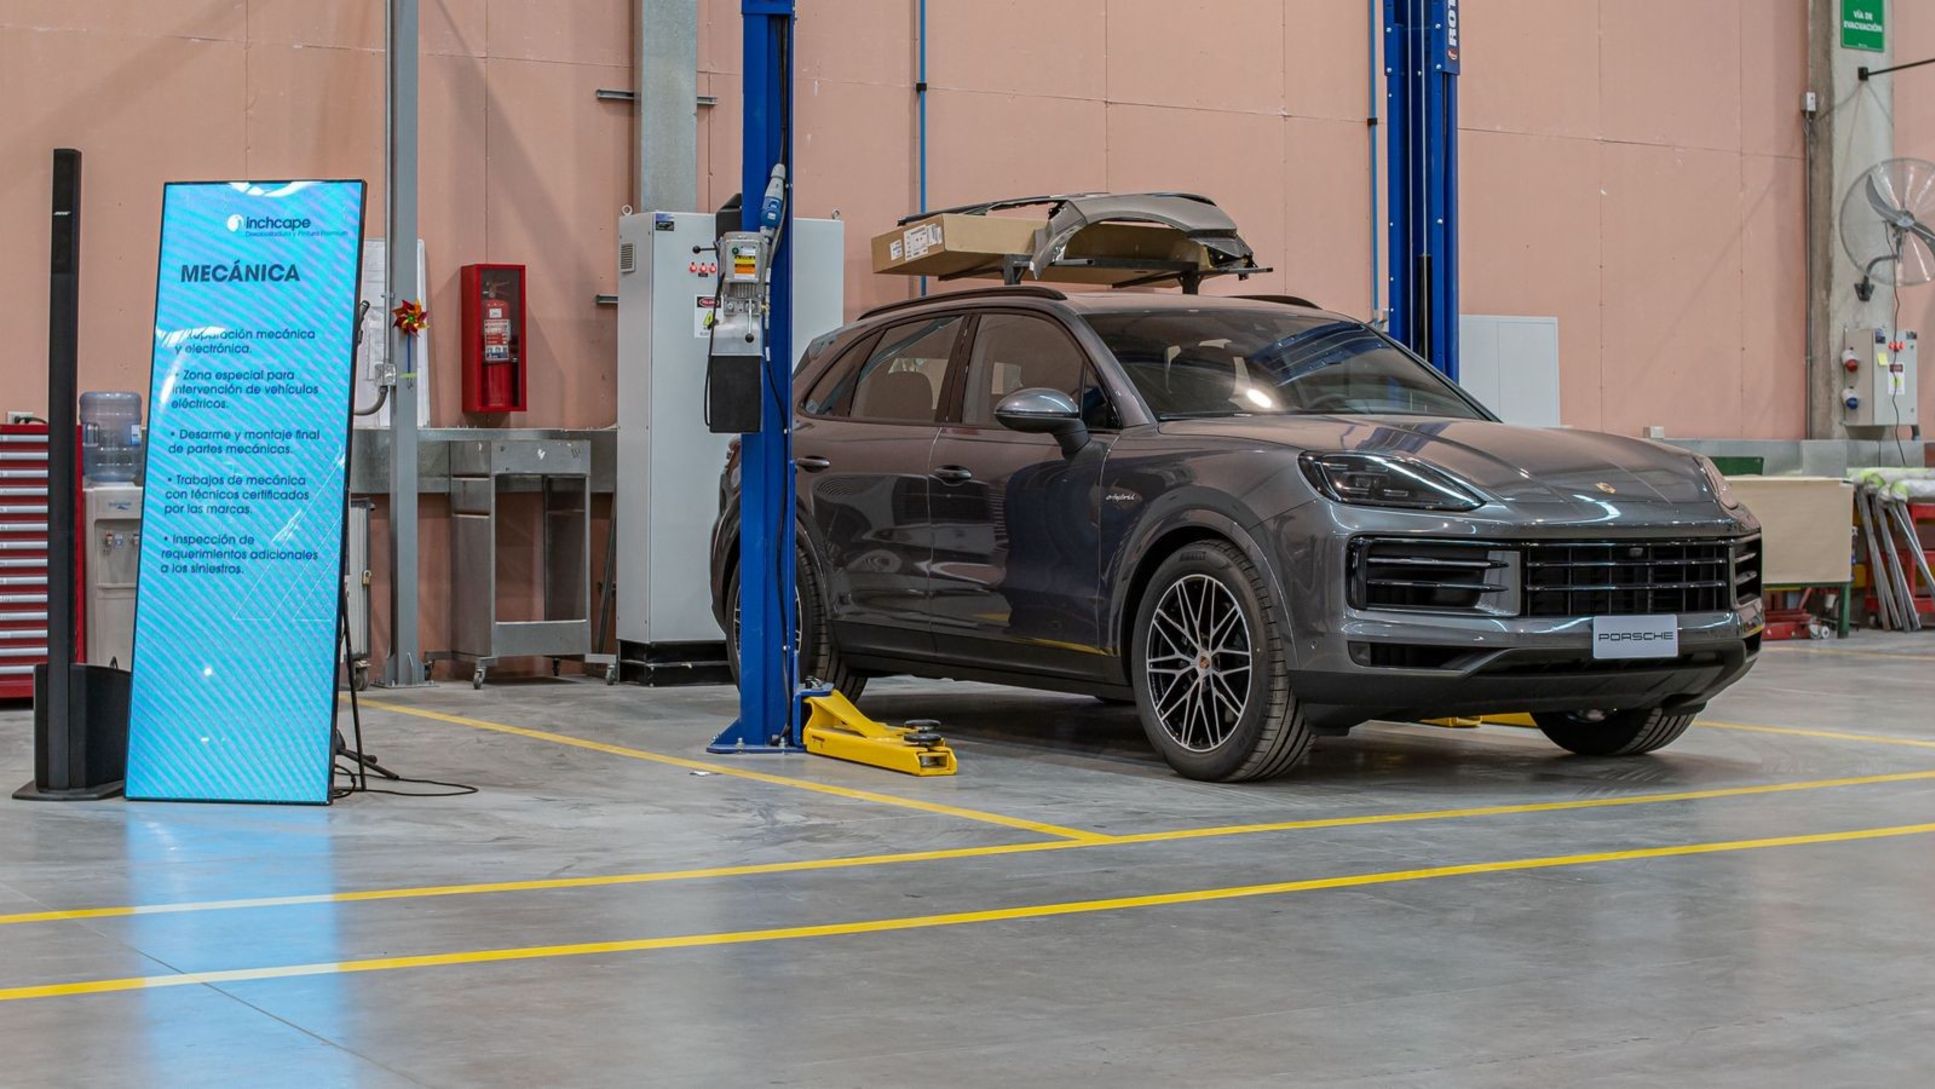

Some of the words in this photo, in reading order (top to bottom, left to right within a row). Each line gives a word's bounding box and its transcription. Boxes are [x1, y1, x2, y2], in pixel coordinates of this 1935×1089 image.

[246, 216, 312, 232] inchcape
[181, 260, 300, 282] MECÁNICA
[187, 329, 253, 341] epación
[256, 329, 315, 340] mecánica
[175, 345, 182, 355] y
[183, 370, 211, 380] Zona
[215, 369, 263, 383] especial
[267, 371, 295, 384] para
[172, 384, 243, 395] intervención
[246, 384, 261, 395] de
[264, 384, 319, 395] vehículos
[171, 398, 229, 409] eléctricos.
[179, 429, 231, 440] Desarme
[234, 431, 242, 442] y
[244, 429, 293, 442] montaje
[295, 429, 320, 440] final
[168, 444, 184, 454] de
[187, 444, 222, 457] partes
[226, 443, 293, 454] mecánicas.
[176, 474, 224, 487] Trabajos
[227, 474, 243, 485] de
[246, 474, 306, 485] mecánica
[165, 490, 187, 500] con
[190, 489, 239, 500] técnicos
[242, 489, 310, 500] certificados
[164, 505, 184, 517] por
[187, 503, 203, 514] las
[206, 505, 253, 514] marcas.
[172, 534, 236, 547] Inspección
[239, 534, 255, 545] de
[161, 549, 247, 561] requerimientos
[250, 549, 318, 560] adicionales
[160, 565, 169, 574] a
[172, 563, 188, 574] los
[190, 563, 244, 574] siniestros.
[1598, 631, 1674, 641] PORSCHE
